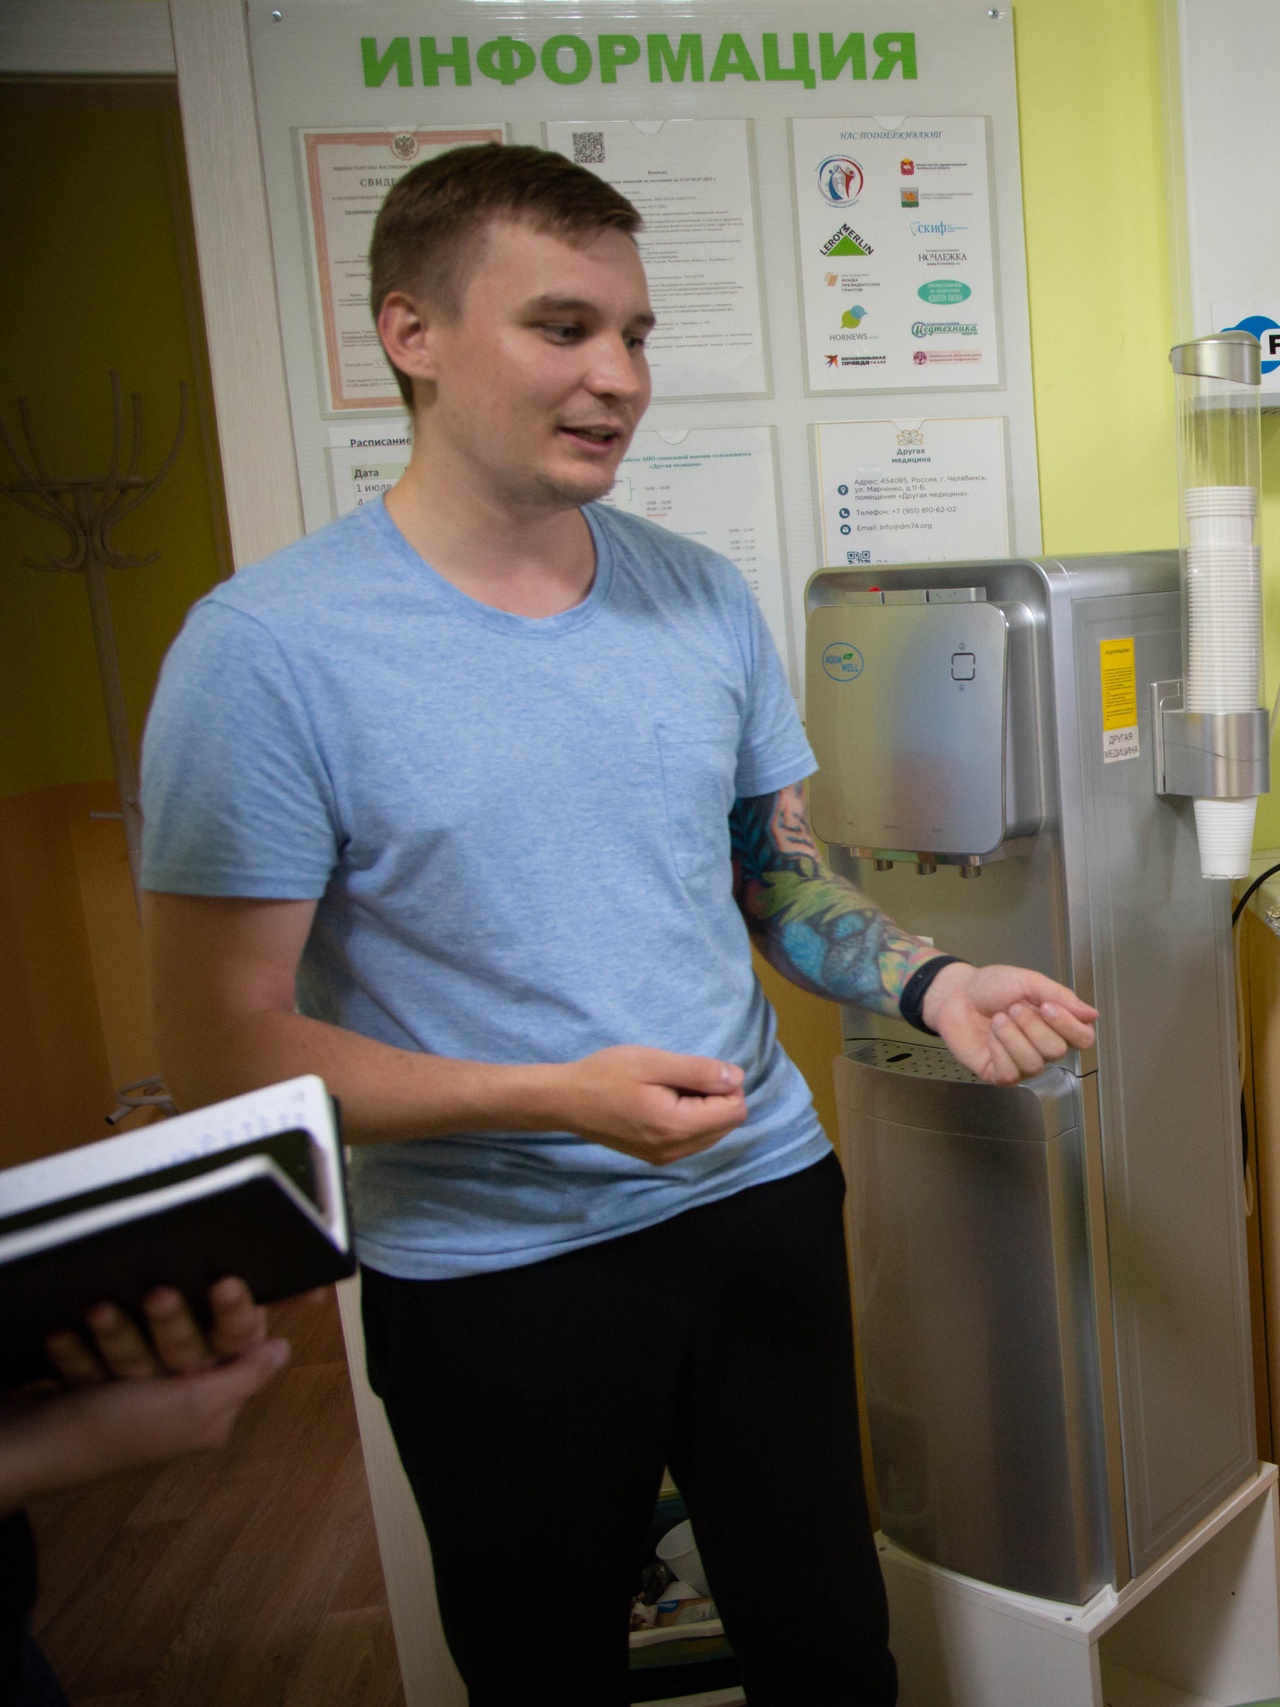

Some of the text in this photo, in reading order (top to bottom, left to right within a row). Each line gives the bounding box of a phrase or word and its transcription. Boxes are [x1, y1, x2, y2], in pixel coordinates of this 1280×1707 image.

[361, 32, 918, 89] ИНФОРМАЦИЯ
[839, 130, 943, 140] НАС ПОДДЕРЖИВАЮТ
[360, 178, 396, 187] СВИДЕ
[819, 223, 875, 256] LEROY MERLIN
[918, 253, 967, 261] НОЧЛЕЖКА
[350, 436, 412, 448] Расписание
[897, 448, 925, 456] Другая
[892, 456, 931, 464] медицина
[354, 469, 379, 480] Дата
[854, 478, 878, 486] Адрес:
[911, 476, 938, 484] Россия,
[356, 484, 392, 492] 1 июля
[902, 507, 920, 515] (951)
[879, 523, 933, 531] info@dm74.org
[826, 655, 842, 665] AQUA
[842, 663, 859, 672] WELL
[1109, 732, 1133, 745] ДРУГАЯ
[1105, 746, 1138, 759] МЕДИЦИНА
